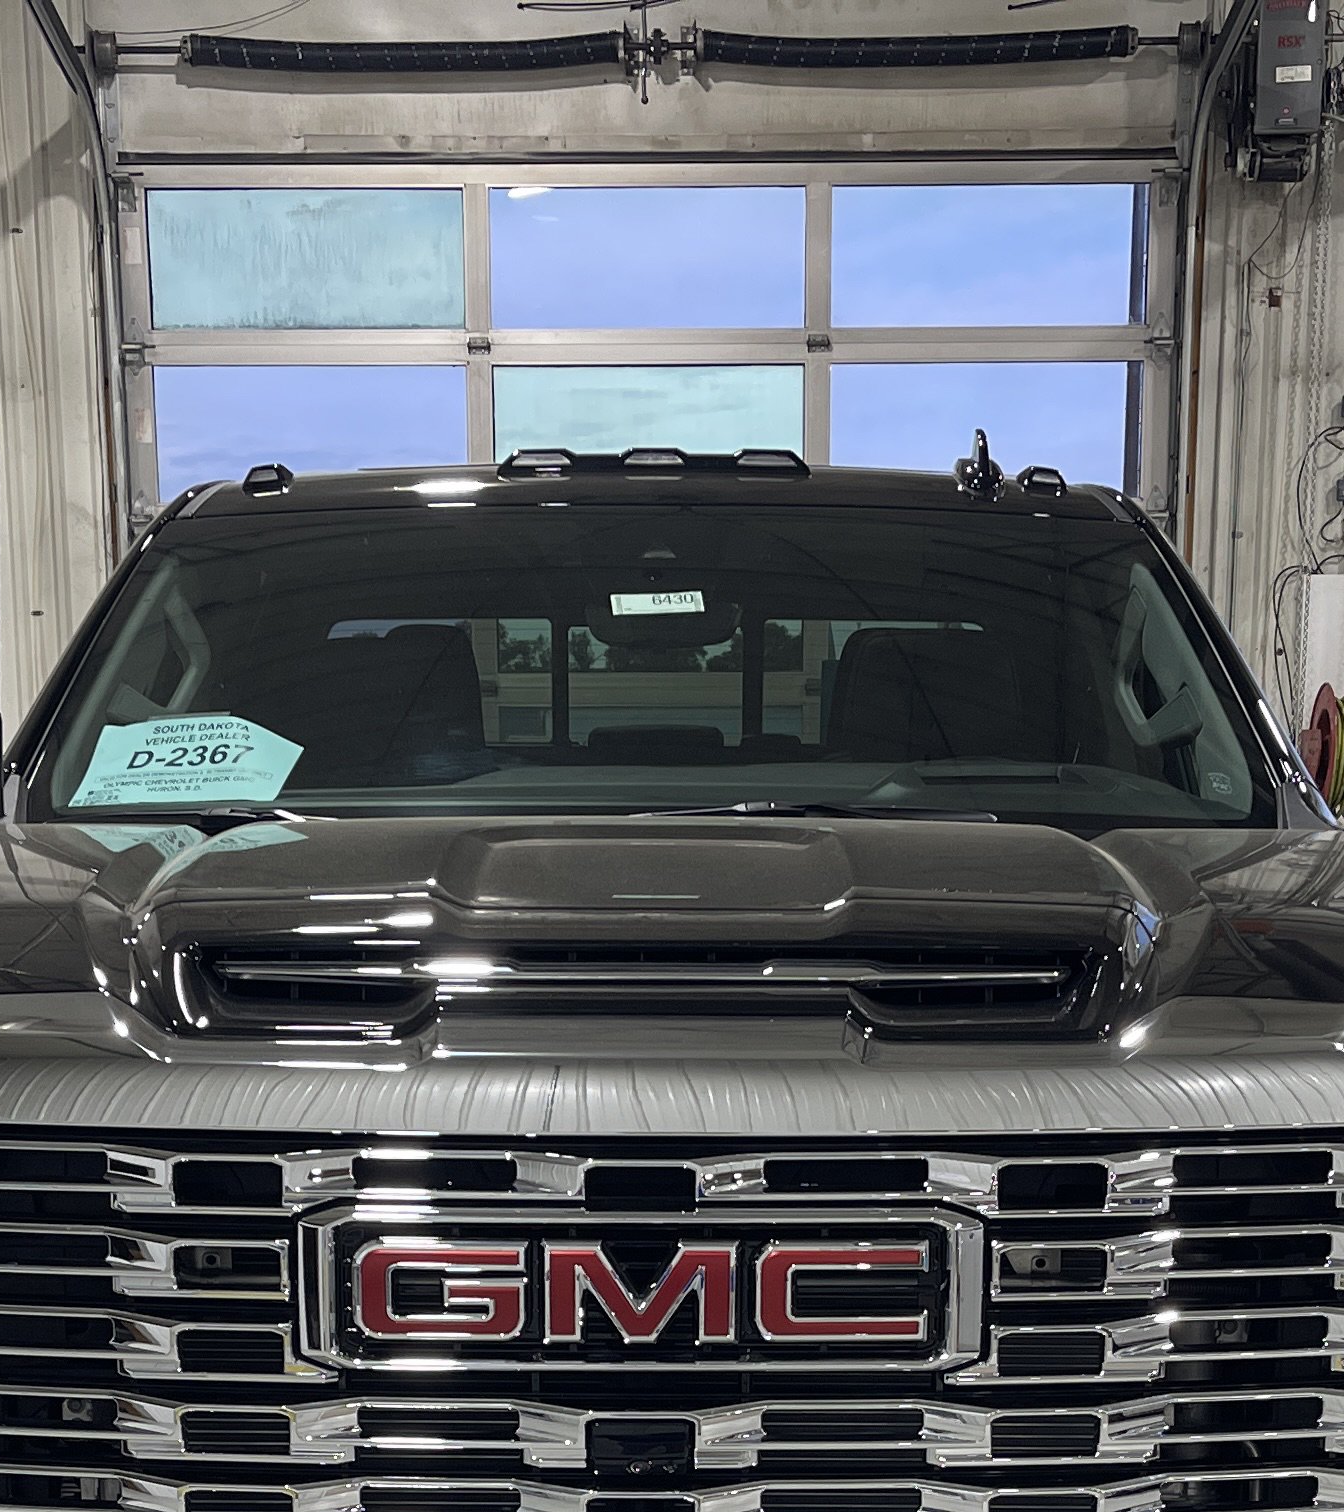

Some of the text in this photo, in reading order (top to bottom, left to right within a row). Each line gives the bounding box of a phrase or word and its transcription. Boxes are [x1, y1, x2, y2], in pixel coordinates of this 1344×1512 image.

[651, 593, 694, 606] 6430
[152, 721, 250, 735] SOUTH DAKOTA
[145, 731, 251, 746] VEHICLE DEALER
[126, 743, 255, 771] D-2367
[145, 776, 200, 786] CHEVROLET
[354, 1238, 930, 1346] GMC
